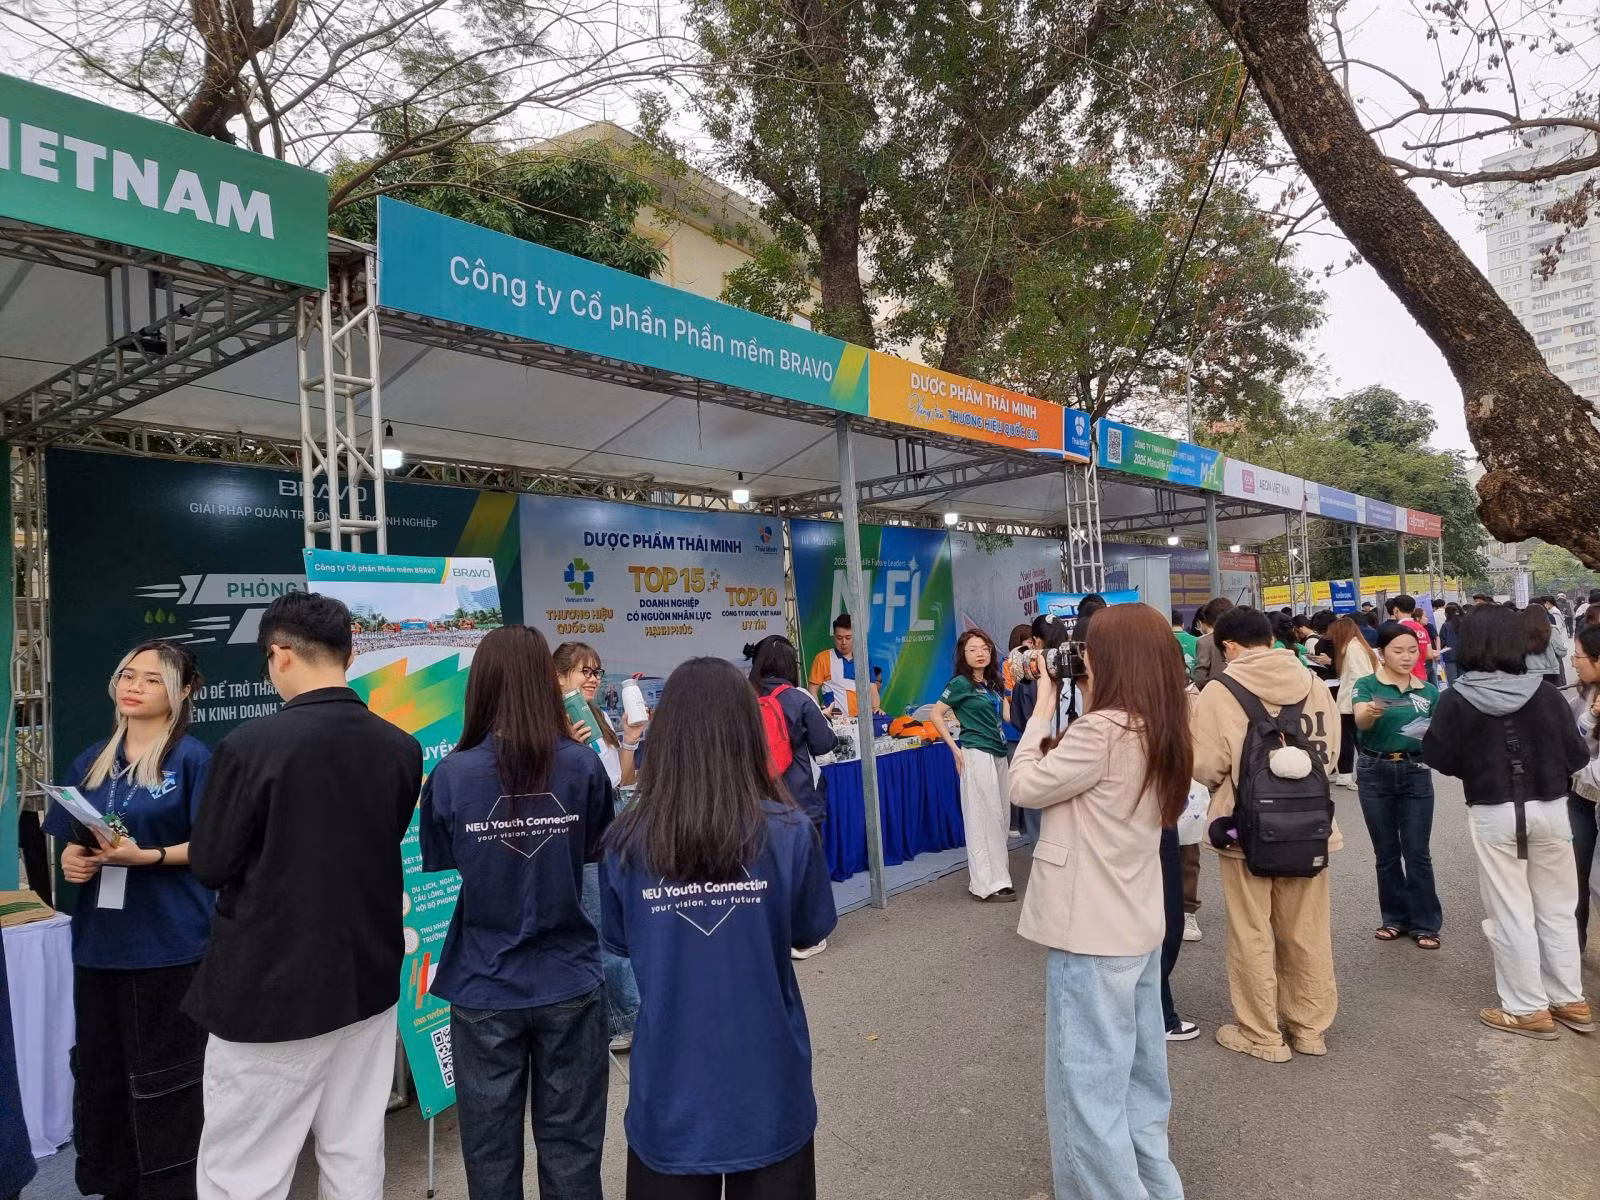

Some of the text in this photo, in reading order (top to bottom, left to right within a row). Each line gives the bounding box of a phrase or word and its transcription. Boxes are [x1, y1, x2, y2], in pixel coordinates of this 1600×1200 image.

[449, 256, 527, 306] Công
[535, 280, 562, 315] ty
[610, 303, 667, 339] phần
[675, 318, 724, 354] Phần
[730, 332, 775, 367] mềm
[779, 349, 834, 382] BRAVO
[911, 373, 1037, 420] DƯỢC PHẨM THÁI MINH
[1134, 453, 1146, 466] 2025
[402, 518, 438, 532] NGHIỆP
[584, 530, 742, 554] DƯỢC PHẨM THÁI MINH
[314, 562, 336, 573] Công
[338, 564, 346, 573] ty
[414, 567, 436, 575] BRAVO
[872, 558, 888, 568] Future
[888, 558, 906, 568] Leaders
[452, 568, 490, 578] BRAVO
[640, 596, 700, 610] DOANH NGHIỆP
[626, 608, 712, 623] CÓ NGUỒN NHÂN LỰC
[722, 610, 737, 618] CÔNG
[587, 624, 605, 634] GIA
[671, 624, 694, 636] PHÚC
[210, 680, 227, 700] ĐỂ
[228, 680, 251, 698] TRỞ
[208, 706, 236, 722] KINH
[240, 702, 277, 719] DOANH
[466, 814, 580, 832] NEU Youth Connection
[477, 834, 498, 842] your
[532, 828, 546, 836] our
[642, 879, 768, 900] NEU Youth Connection
[650, 896, 761, 914] your vision, our future
